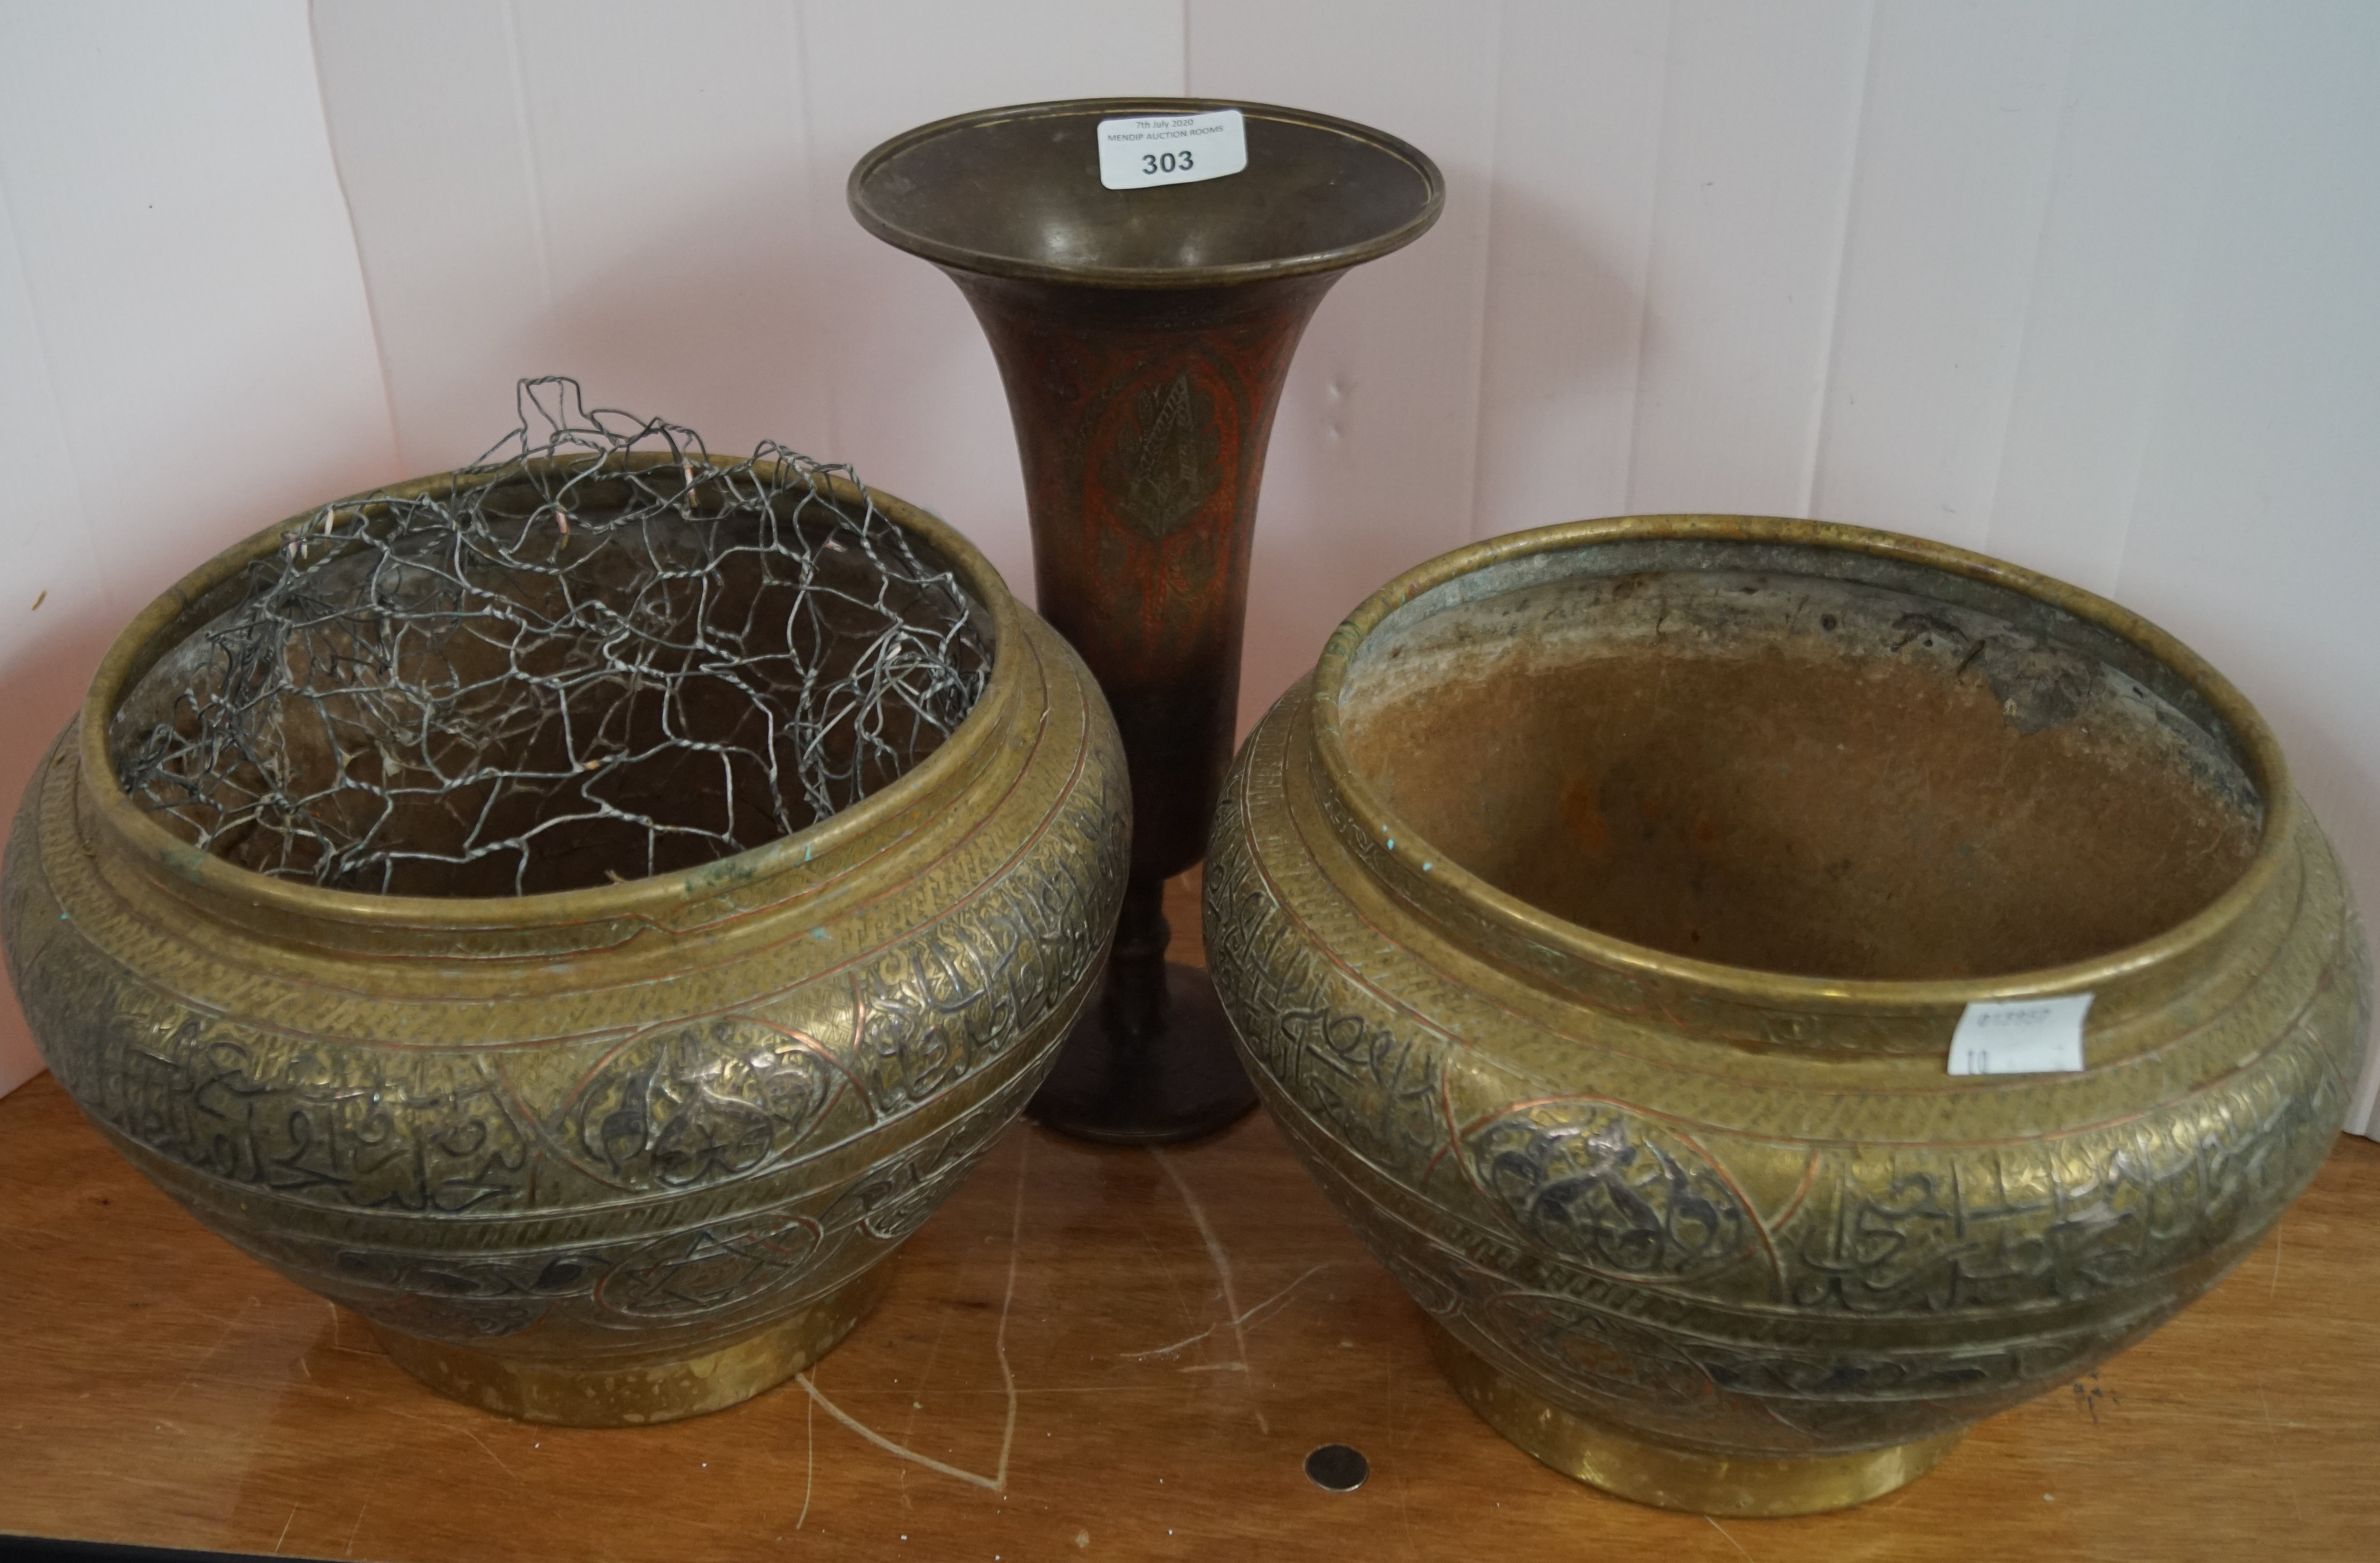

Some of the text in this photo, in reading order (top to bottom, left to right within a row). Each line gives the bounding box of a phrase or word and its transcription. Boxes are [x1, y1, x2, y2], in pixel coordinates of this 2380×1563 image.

[1153, 120, 1169, 128] July
[1146, 131, 1187, 140] AUCTION
[1190, 126, 1224, 136] ROOMS
[1142, 151, 1193, 175] 303
